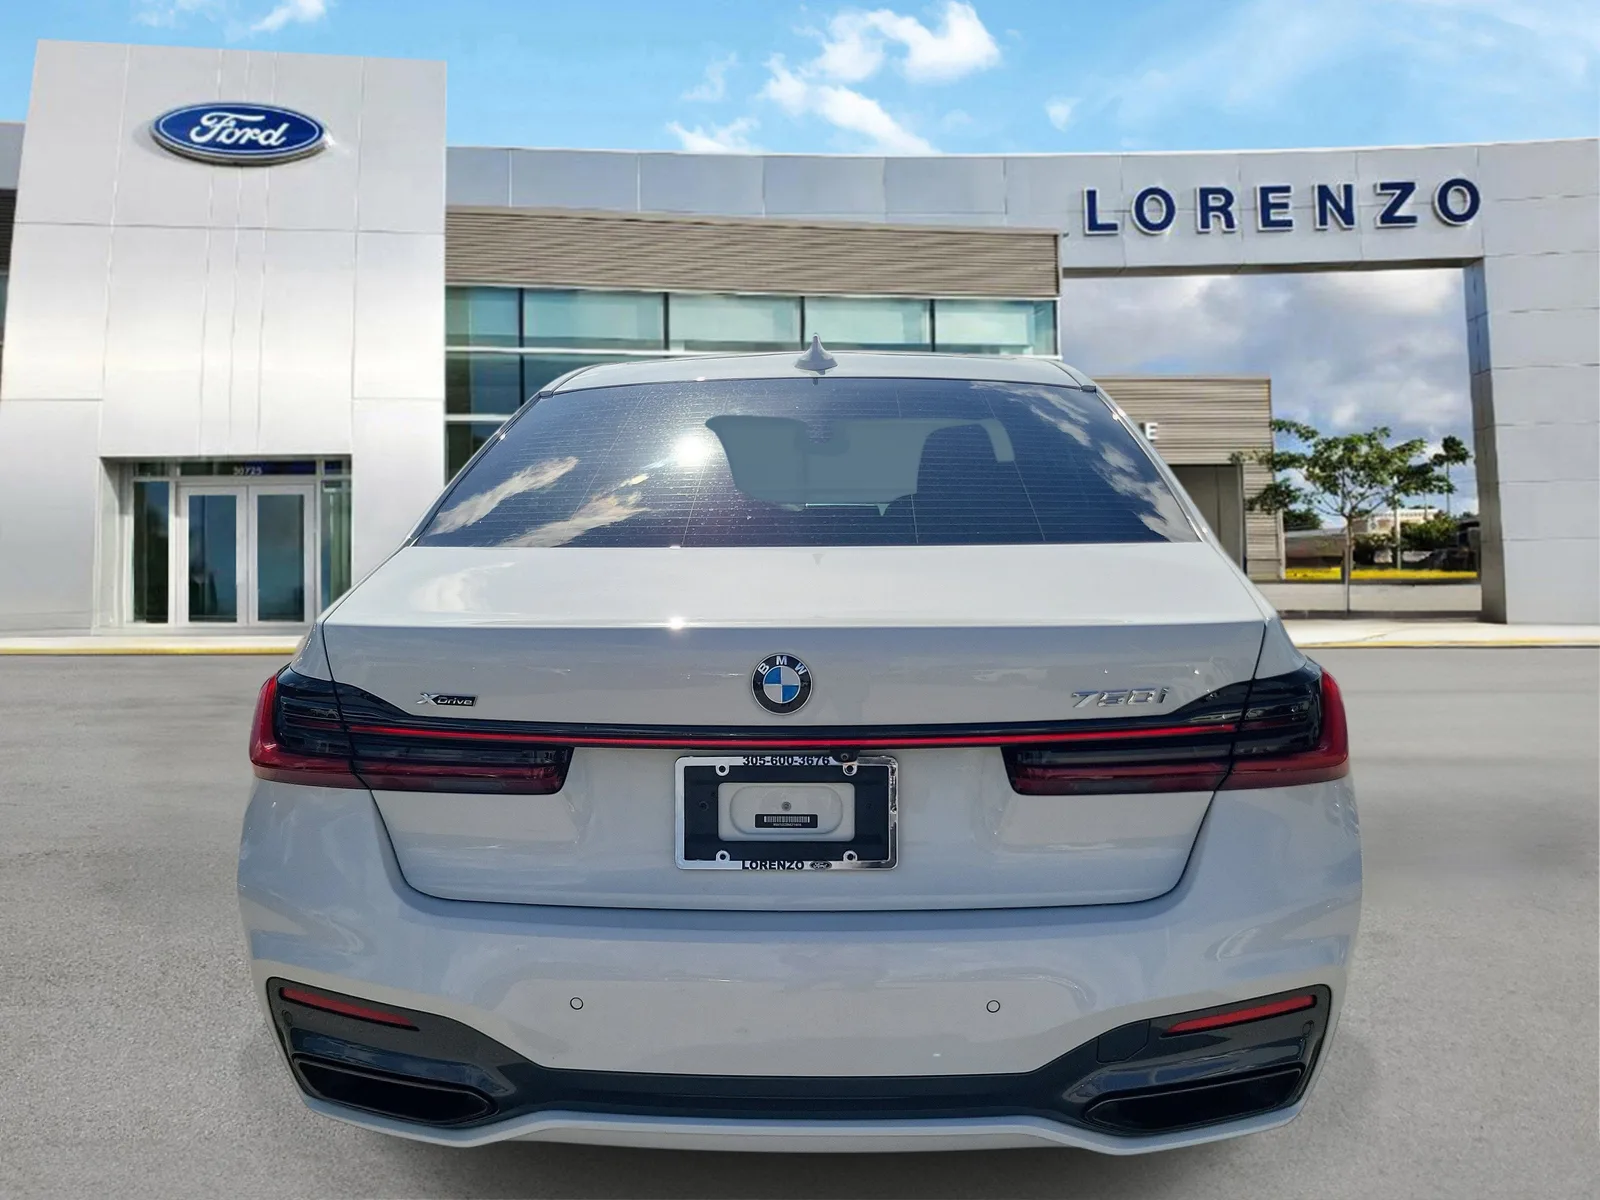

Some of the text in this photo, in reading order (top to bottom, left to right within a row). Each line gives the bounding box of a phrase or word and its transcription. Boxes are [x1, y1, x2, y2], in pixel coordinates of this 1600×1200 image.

[189, 111, 291, 147] Ford
[1084, 177, 1482, 236] LORENZO
[757, 655, 808, 676] BMW
[1071, 686, 1170, 708] 750i
[742, 755, 830, 766] 305-600-3676
[742, 860, 805, 870] LORENZO
